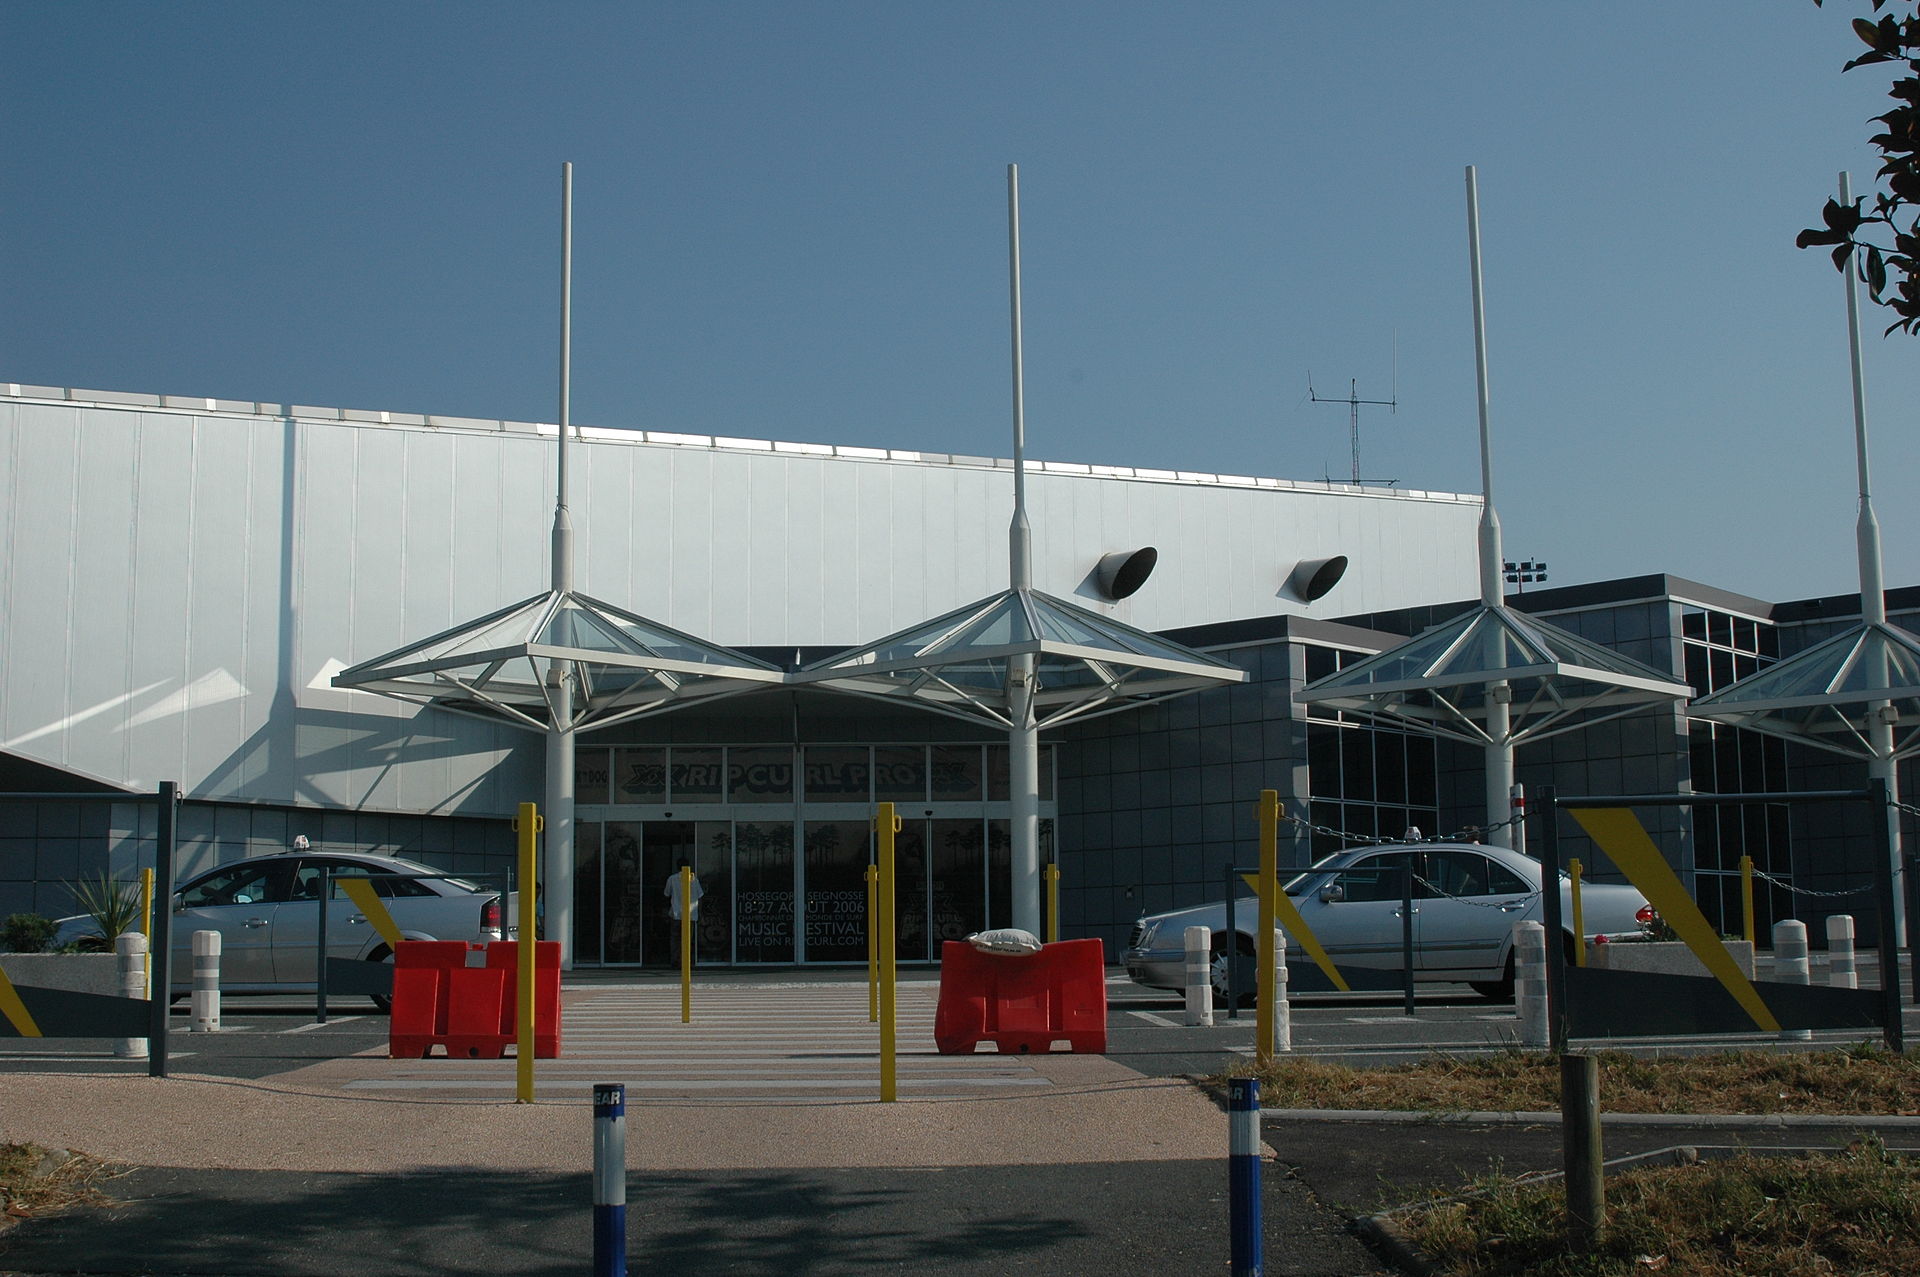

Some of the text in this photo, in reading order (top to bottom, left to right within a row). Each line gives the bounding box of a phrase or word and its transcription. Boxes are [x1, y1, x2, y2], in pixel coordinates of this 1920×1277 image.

[807, 891, 865, 901] SEIGNOSSE
[738, 901, 774, 914] 18-27
[833, 901, 865, 913] 2006
[738, 922, 865, 936] MUSIC ESTIVAL
[739, 936, 865, 947] LIVE ON RICURL.COM
